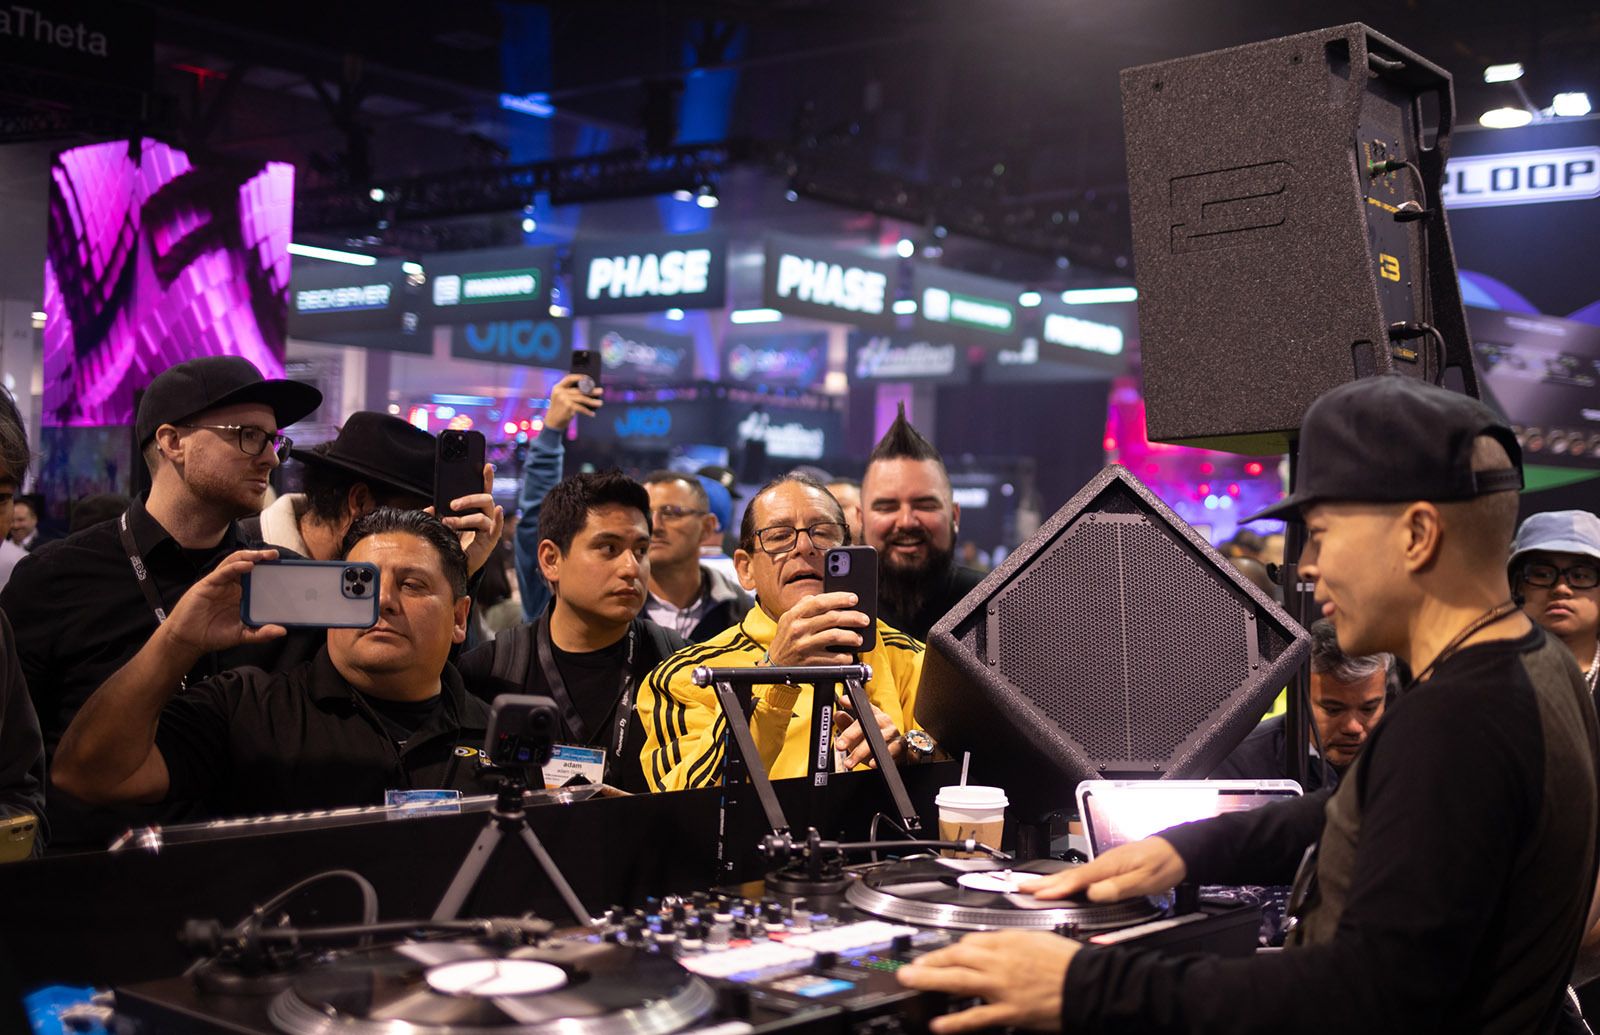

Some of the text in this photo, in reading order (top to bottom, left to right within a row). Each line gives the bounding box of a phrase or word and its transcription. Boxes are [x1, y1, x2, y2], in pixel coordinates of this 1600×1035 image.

[587, 248, 711, 299] PHASE
[777, 254, 887, 314] PHASE
[619, 718, 627, 732] DJ
[562, 761, 582, 769] adam
